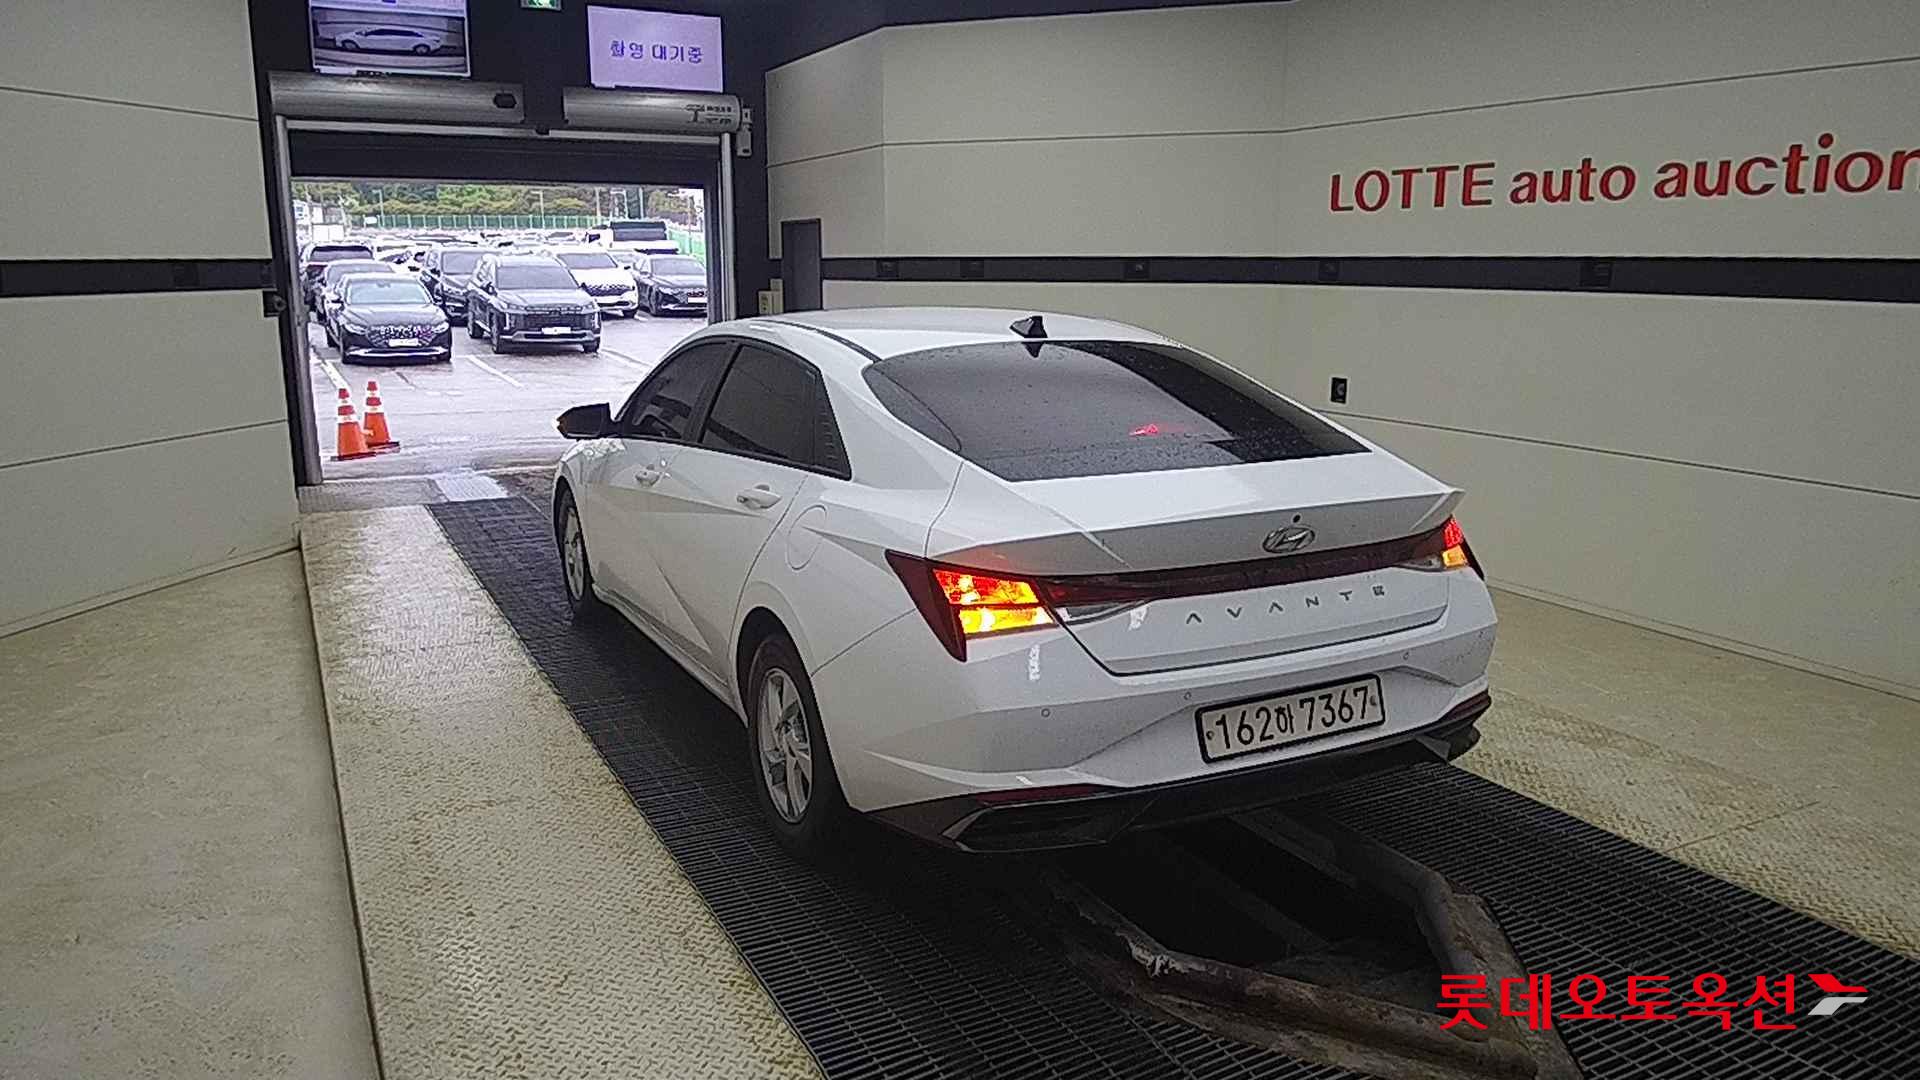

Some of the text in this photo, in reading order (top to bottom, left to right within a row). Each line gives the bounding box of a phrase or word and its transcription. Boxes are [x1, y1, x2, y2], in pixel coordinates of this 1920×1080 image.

[652, 44, 702, 64] 대기중
[1330, 162, 1495, 211] LOTTE
[1510, 158, 1636, 204] auto
[1186, 585, 1386, 625] AVANTE
